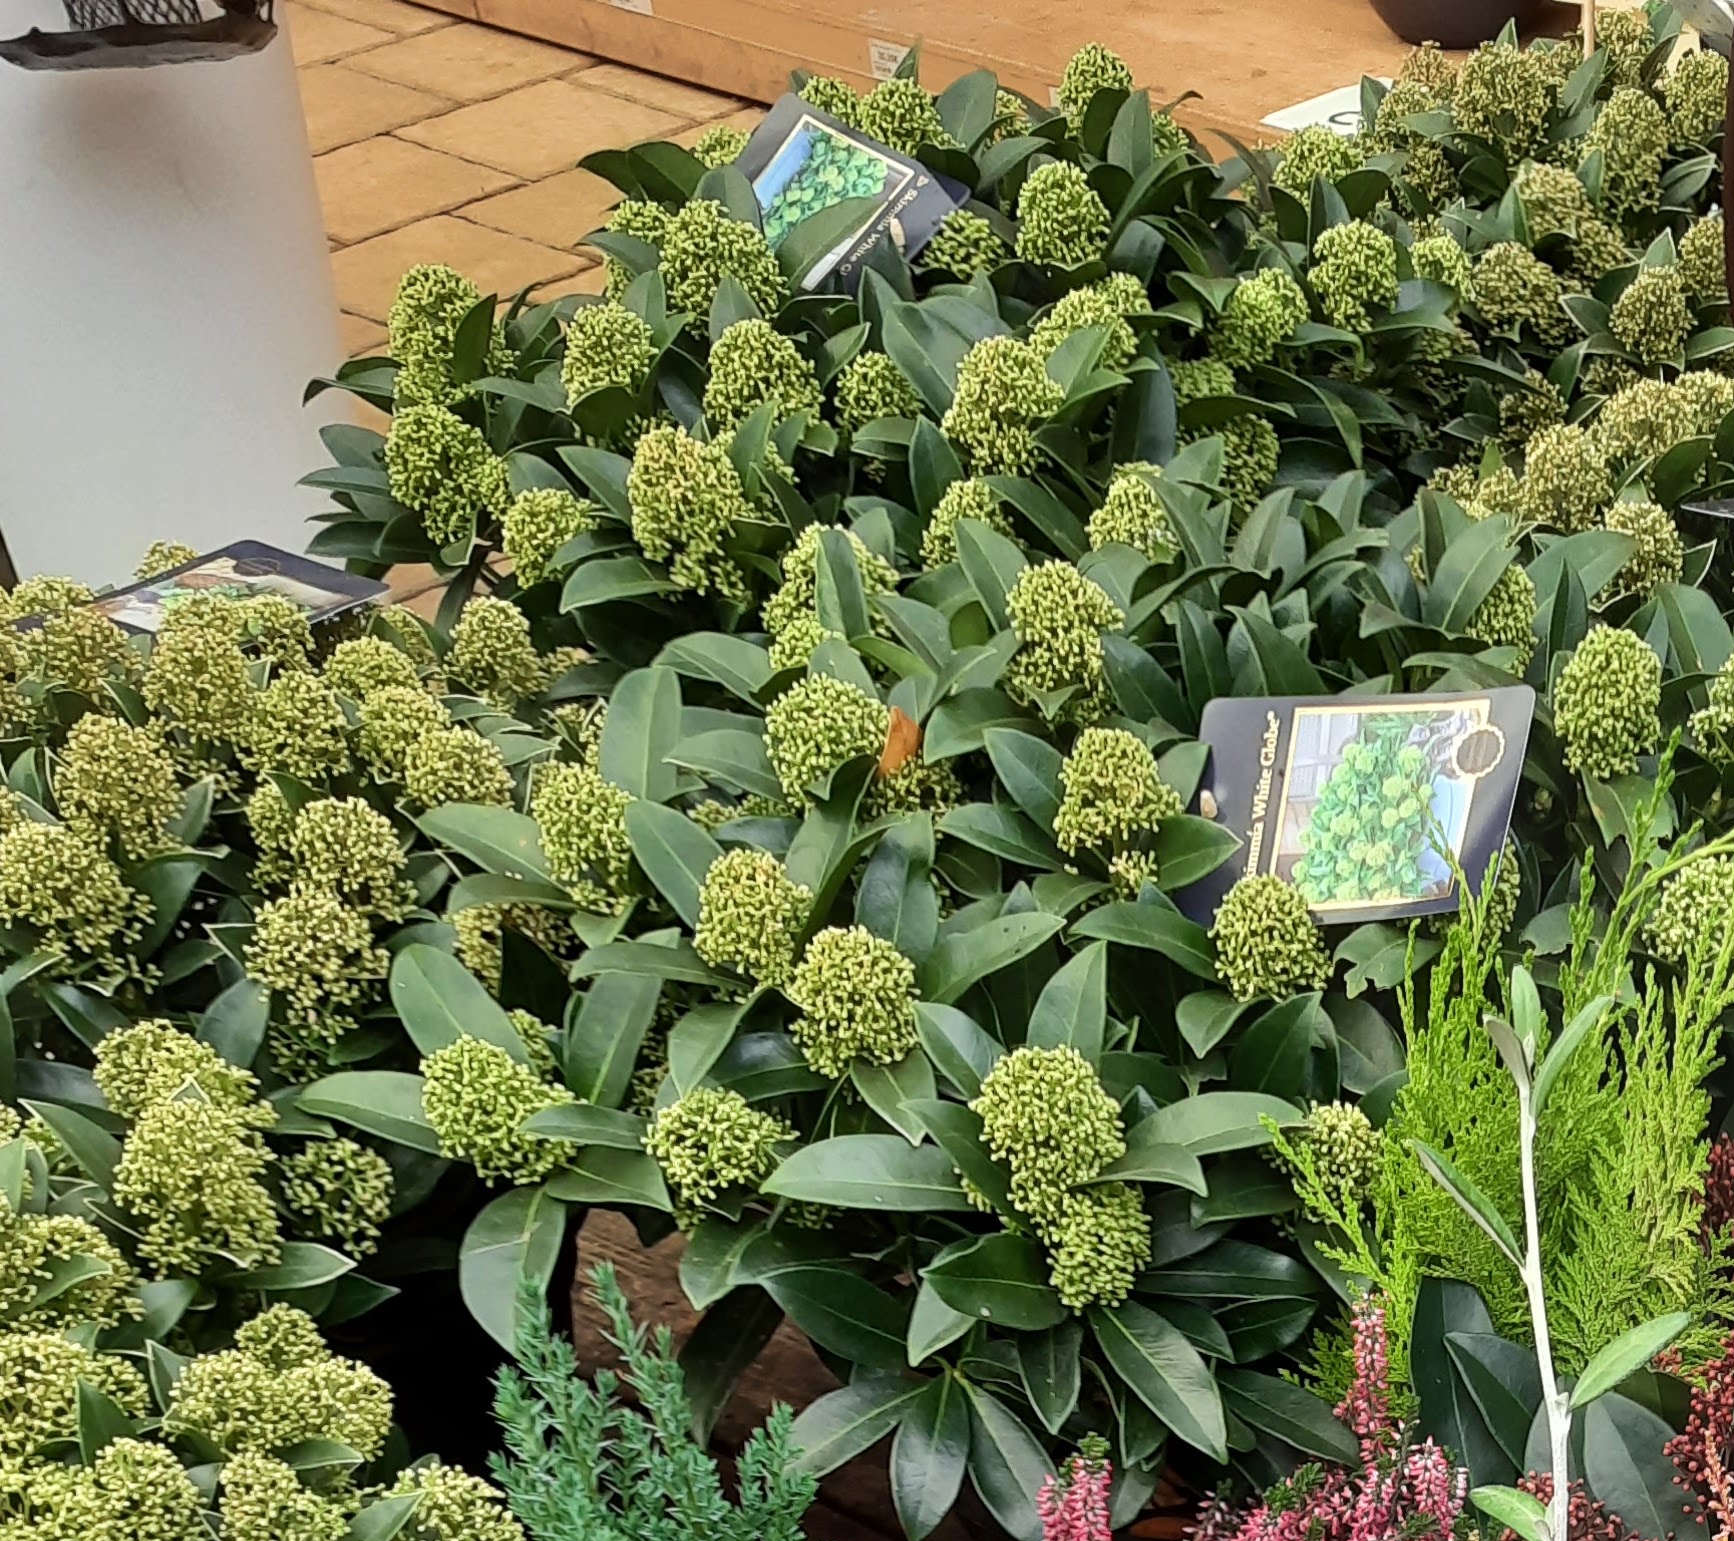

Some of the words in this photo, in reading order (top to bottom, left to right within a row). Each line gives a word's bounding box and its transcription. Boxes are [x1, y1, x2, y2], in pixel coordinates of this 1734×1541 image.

[849, 233, 880, 262] White
[1252, 768, 1272, 819] White
[1241, 821, 1264, 881] kimmia
